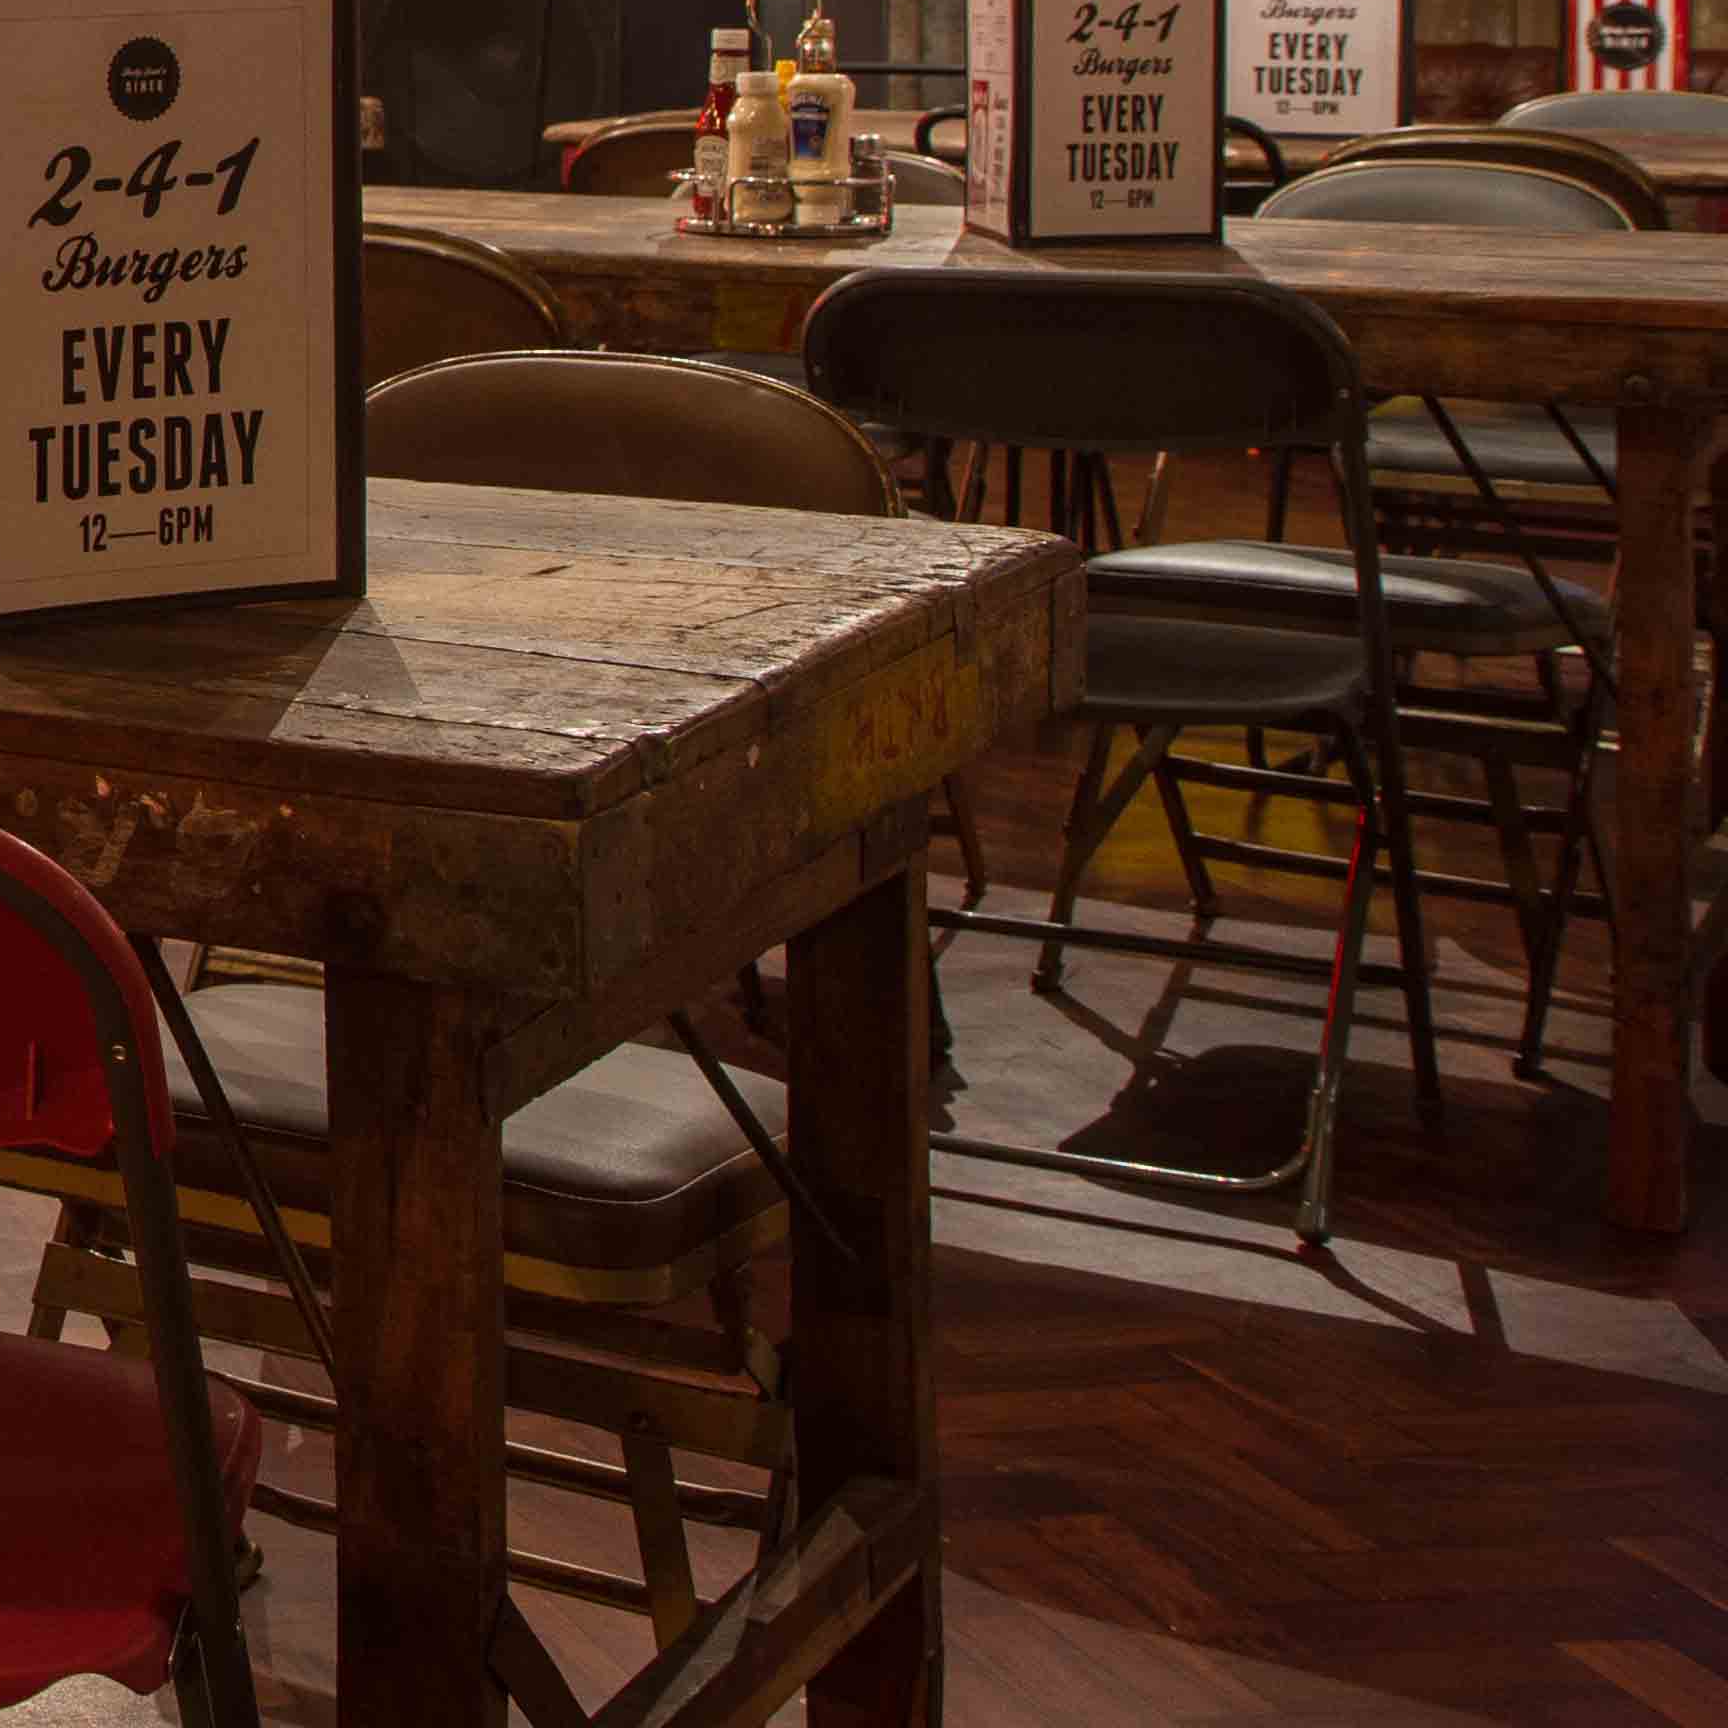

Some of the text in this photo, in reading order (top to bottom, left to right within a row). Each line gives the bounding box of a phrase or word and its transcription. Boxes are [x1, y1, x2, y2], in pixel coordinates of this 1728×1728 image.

[1066, 2, 1181, 43] 2-4-1
[1259, 0, 1358, 24] Burgers
[1073, 48, 1173, 85] Burgers
[1268, 33, 1348, 62] EVERY
[1254, 66, 1363, 97] TUESDAY
[1082, 94, 1163, 134] EVERY
[29, 138, 261, 228] 2-4-1
[1066, 142, 1179, 183] TUESDAY
[41, 232, 249, 304] Burgers
[62, 318, 231, 405] EVERY
[28, 409, 264, 504] TUESDAY
